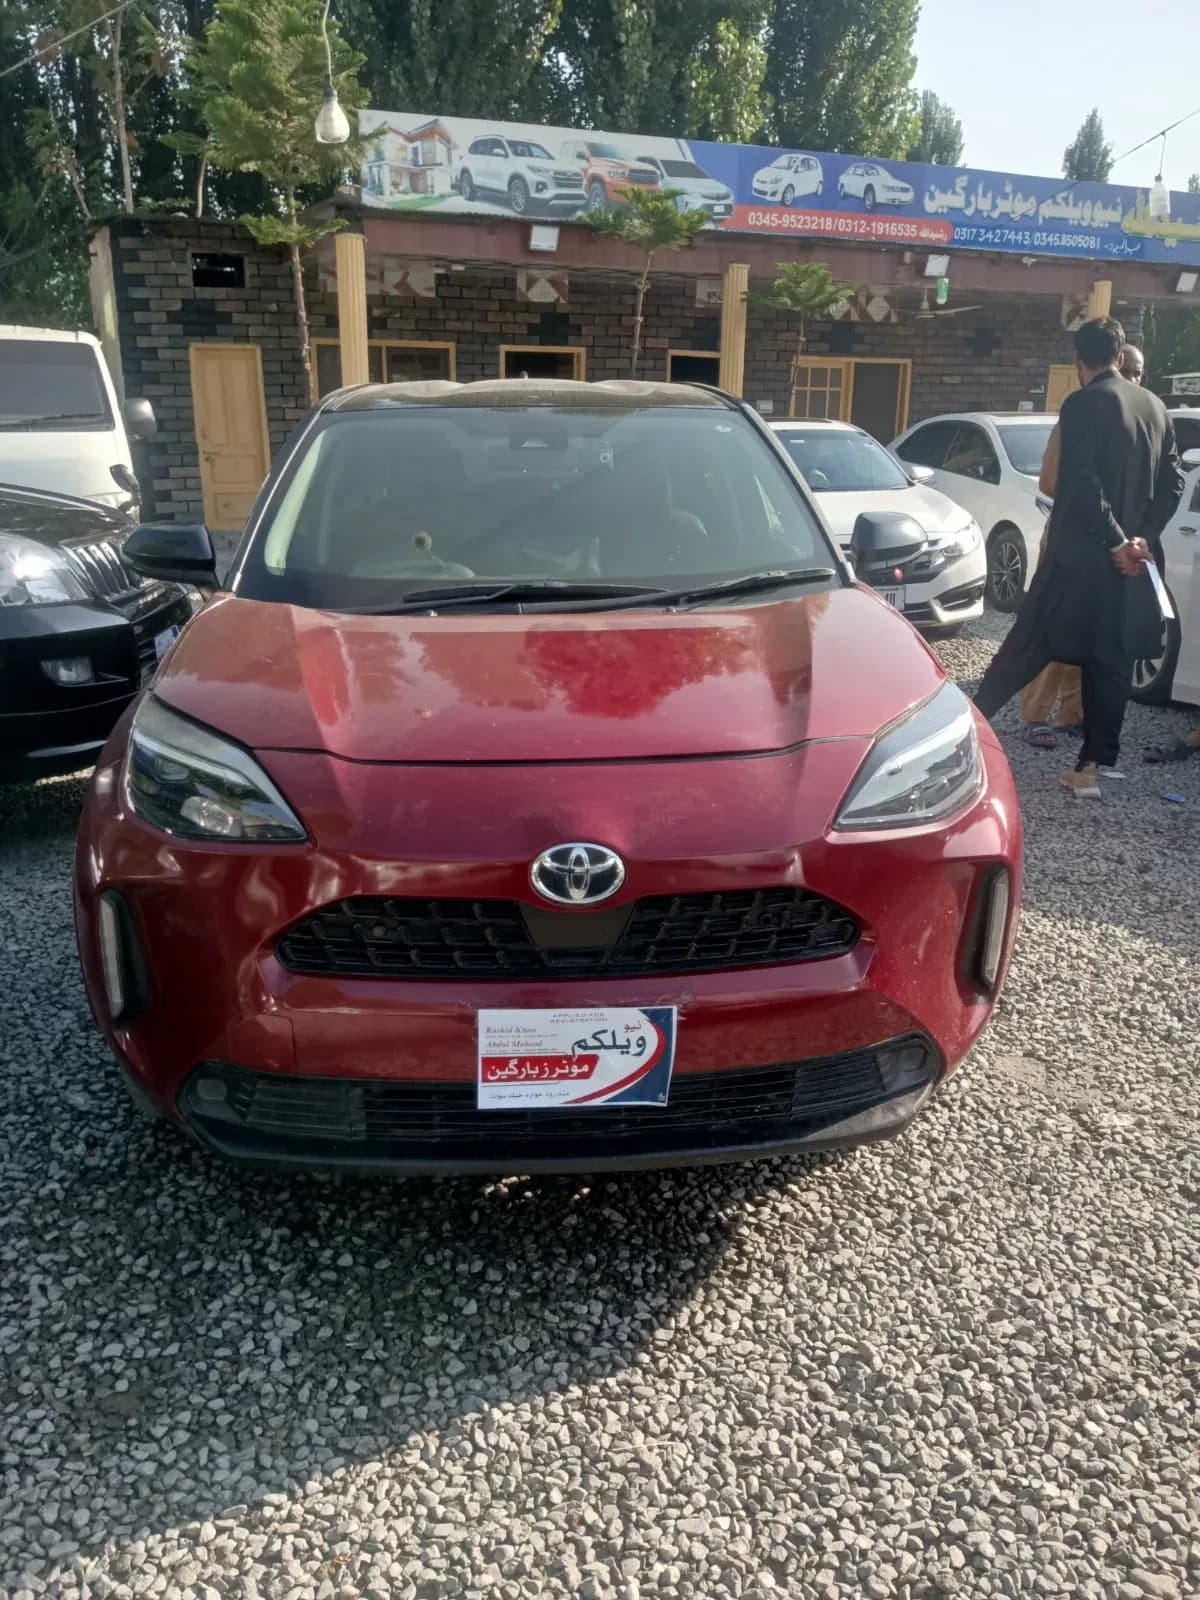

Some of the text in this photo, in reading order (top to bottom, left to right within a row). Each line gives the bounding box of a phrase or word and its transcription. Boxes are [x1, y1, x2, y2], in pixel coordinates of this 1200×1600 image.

[748, 211, 918, 237] 0345-9523218/0312-1916535
[953, 228, 977, 242] 0317
[571, 1029, 647, 1059] ویلکم
